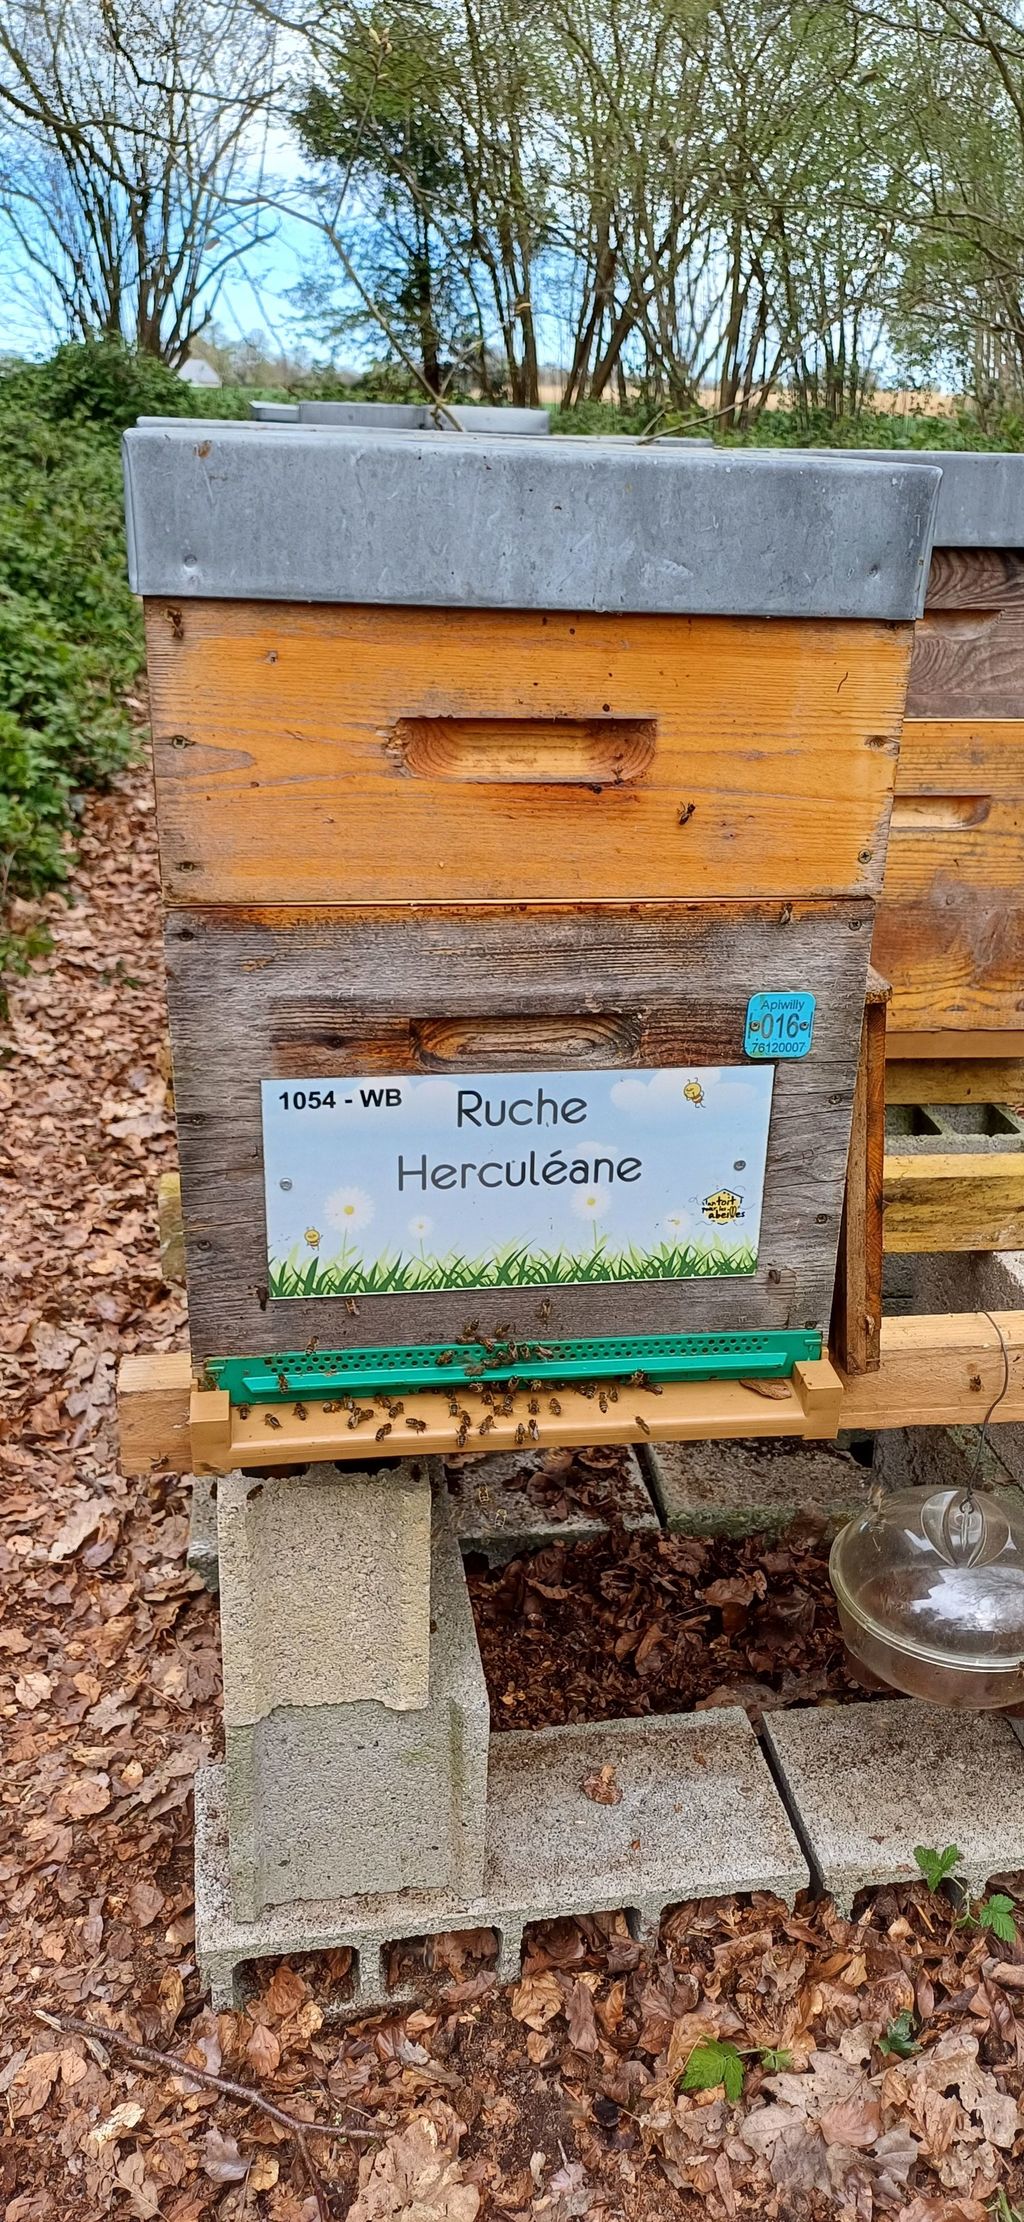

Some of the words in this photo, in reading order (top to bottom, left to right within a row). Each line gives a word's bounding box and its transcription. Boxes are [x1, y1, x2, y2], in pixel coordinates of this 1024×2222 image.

[760, 1000, 805, 1012] Apiwilly
[761, 1013, 800, 1039] 016
[752, 1042, 806, 1053] 76120007
[278, 1091, 337, 1110] 1054
[359, 1088, 402, 1108] WB
[457, 1087, 588, 1128] Ruche
[398, 1149, 643, 1192] Herculéane
[708, 1206, 746, 1219] abeilles
